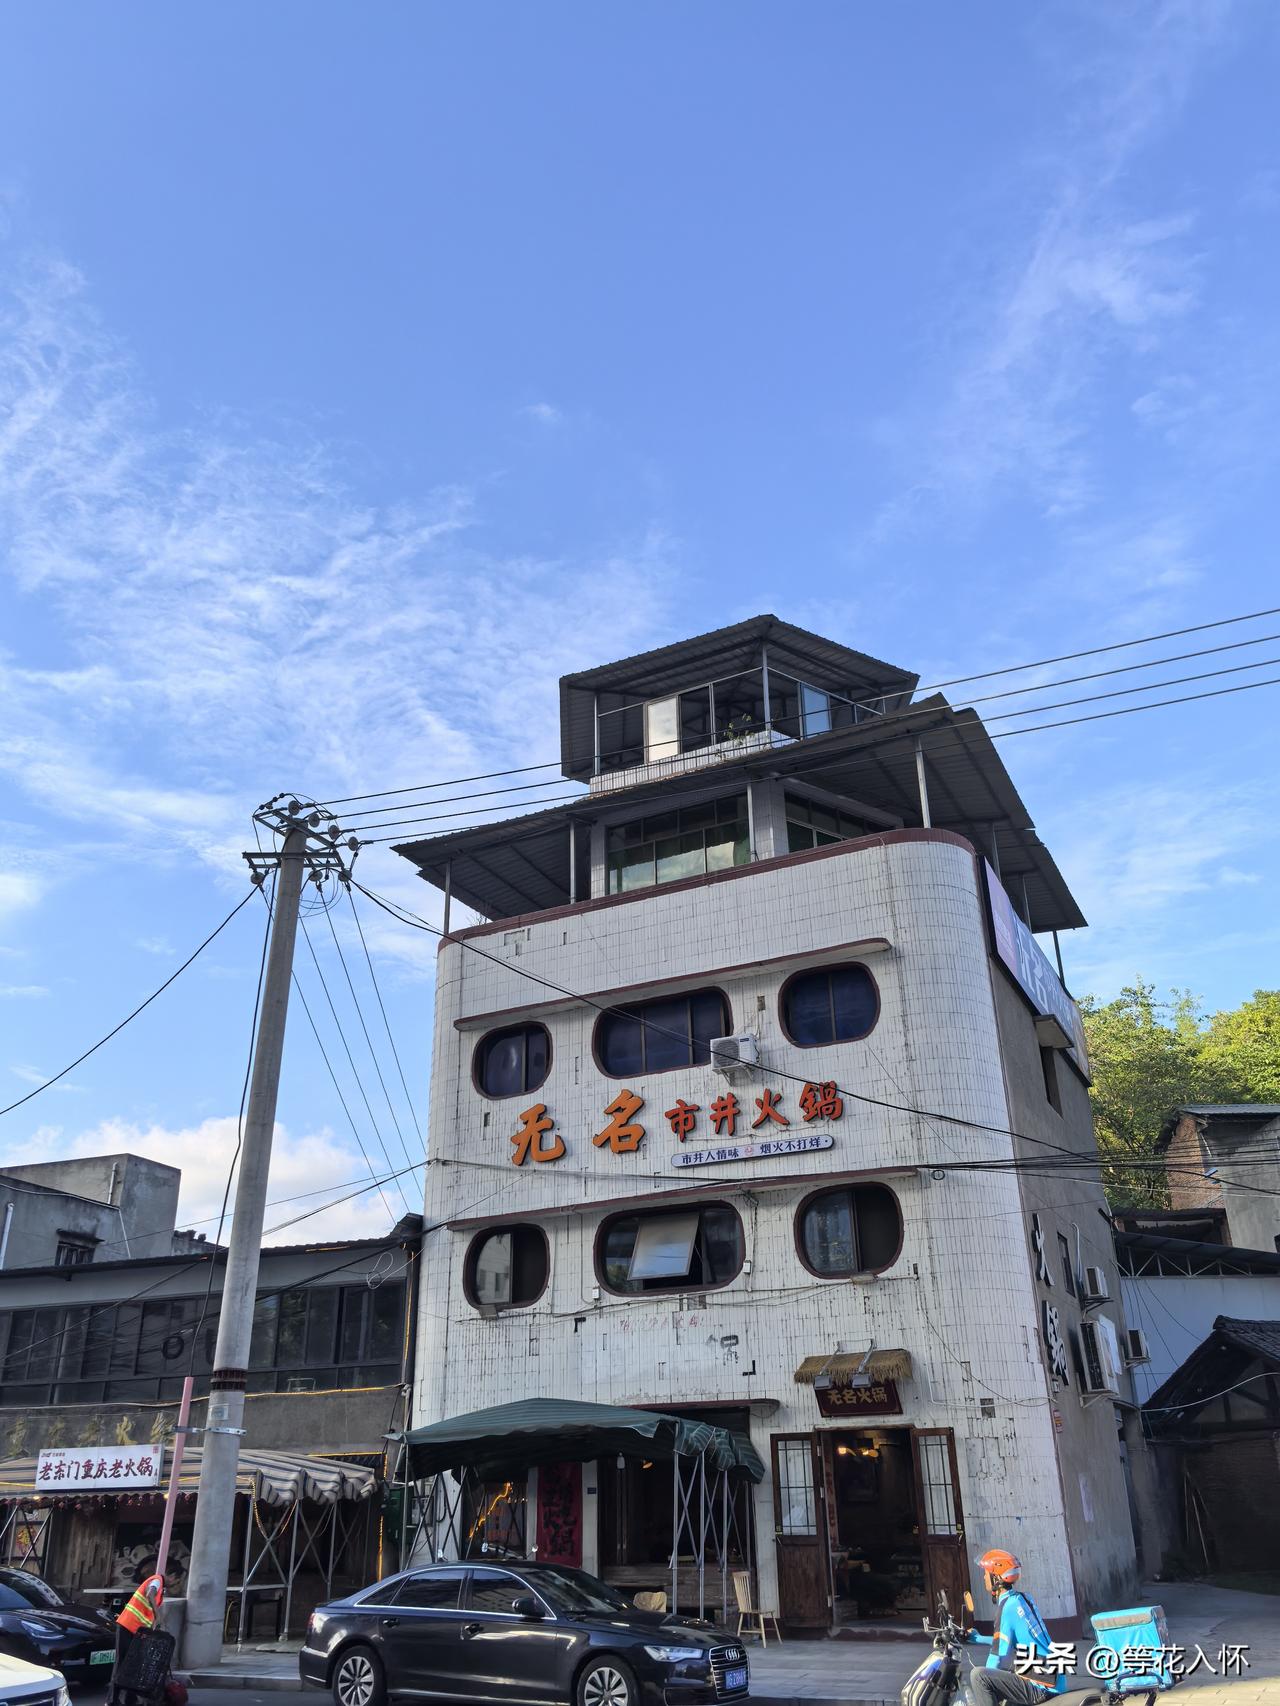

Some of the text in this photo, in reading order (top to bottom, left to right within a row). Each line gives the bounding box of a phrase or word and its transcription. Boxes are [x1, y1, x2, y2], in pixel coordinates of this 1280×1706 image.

[511, 1088, 647, 1167] 无名
[681, 1136, 821, 1165] 市井人情味 烟火不打烊
[38, 1456, 154, 1481] 老东门重庆老火锅
